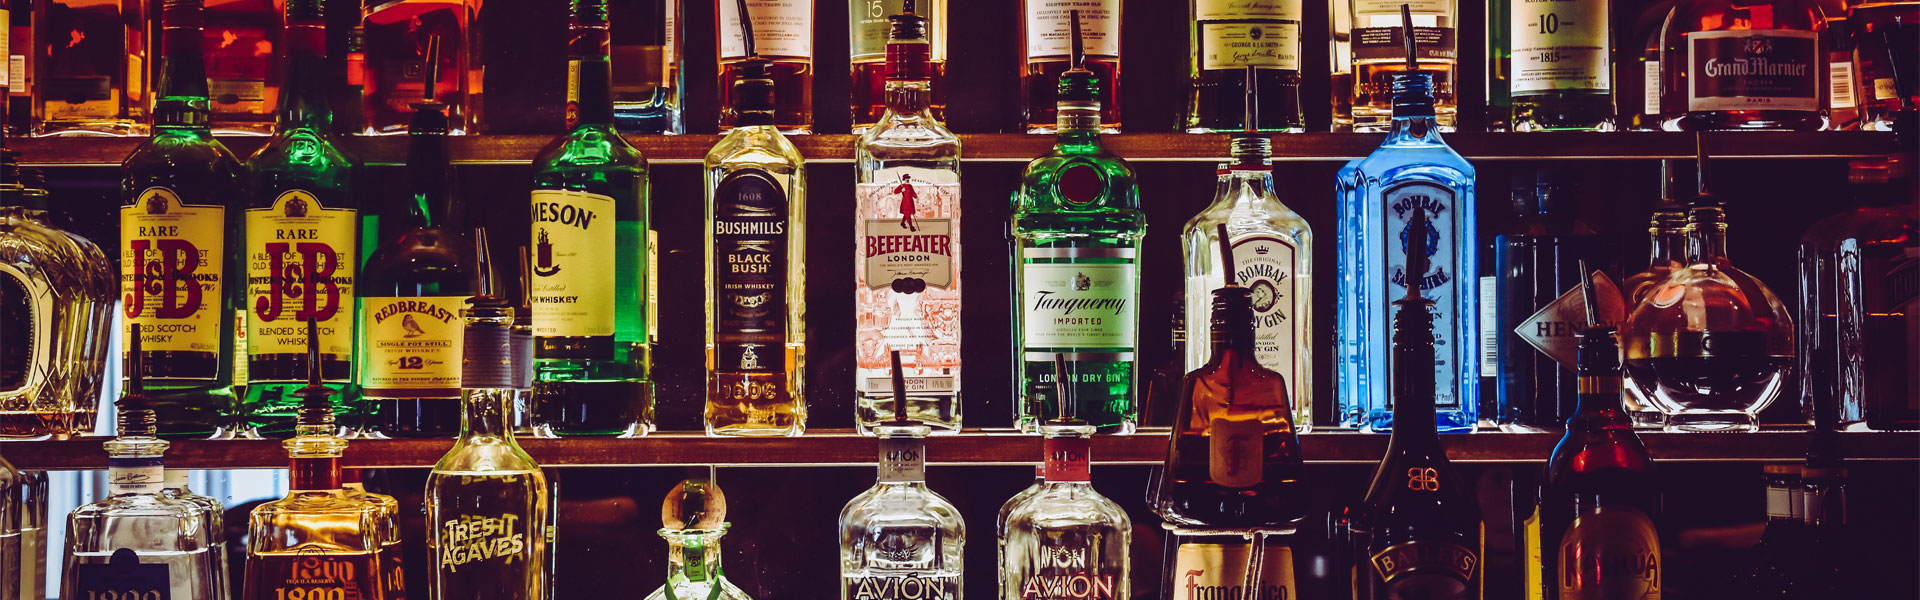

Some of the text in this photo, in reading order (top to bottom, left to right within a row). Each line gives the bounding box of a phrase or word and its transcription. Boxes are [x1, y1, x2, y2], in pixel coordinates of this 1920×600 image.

[866, 1, 883, 18] 15
[1539, 13, 1559, 34] 10
[1540, 52, 1560, 63] 1815
[1704, 57, 1807, 77] Grand Marnier
[738, 192, 762, 201] 1608
[139, 226, 179, 237] RARE
[276, 229, 319, 239] RARE
[716, 221, 784, 234] BUSHMILLS
[866, 234, 952, 258] BEEFEATER
[728, 254, 771, 263] BLACK
[732, 264, 767, 273] BUSH
[1237, 264, 1287, 285] BOMBAY
[1034, 291, 1127, 316] Tanqueray
[374, 300, 455, 324] REDBREAST
[1264, 309, 1287, 328] GIN
[157, 324, 197, 333] SCOTCH
[259, 328, 294, 336] BLENDED
[277, 338, 308, 346] WHISK
[398, 356, 423, 369] 12
[1082, 374, 1102, 383] DRY
[1106, 374, 1121, 383] GIN
[445, 518, 496, 552] TRES
[441, 533, 524, 573] AGAVES
[855, 572, 946, 600] AVIÓN
[1022, 571, 1114, 600] AVIÓN
